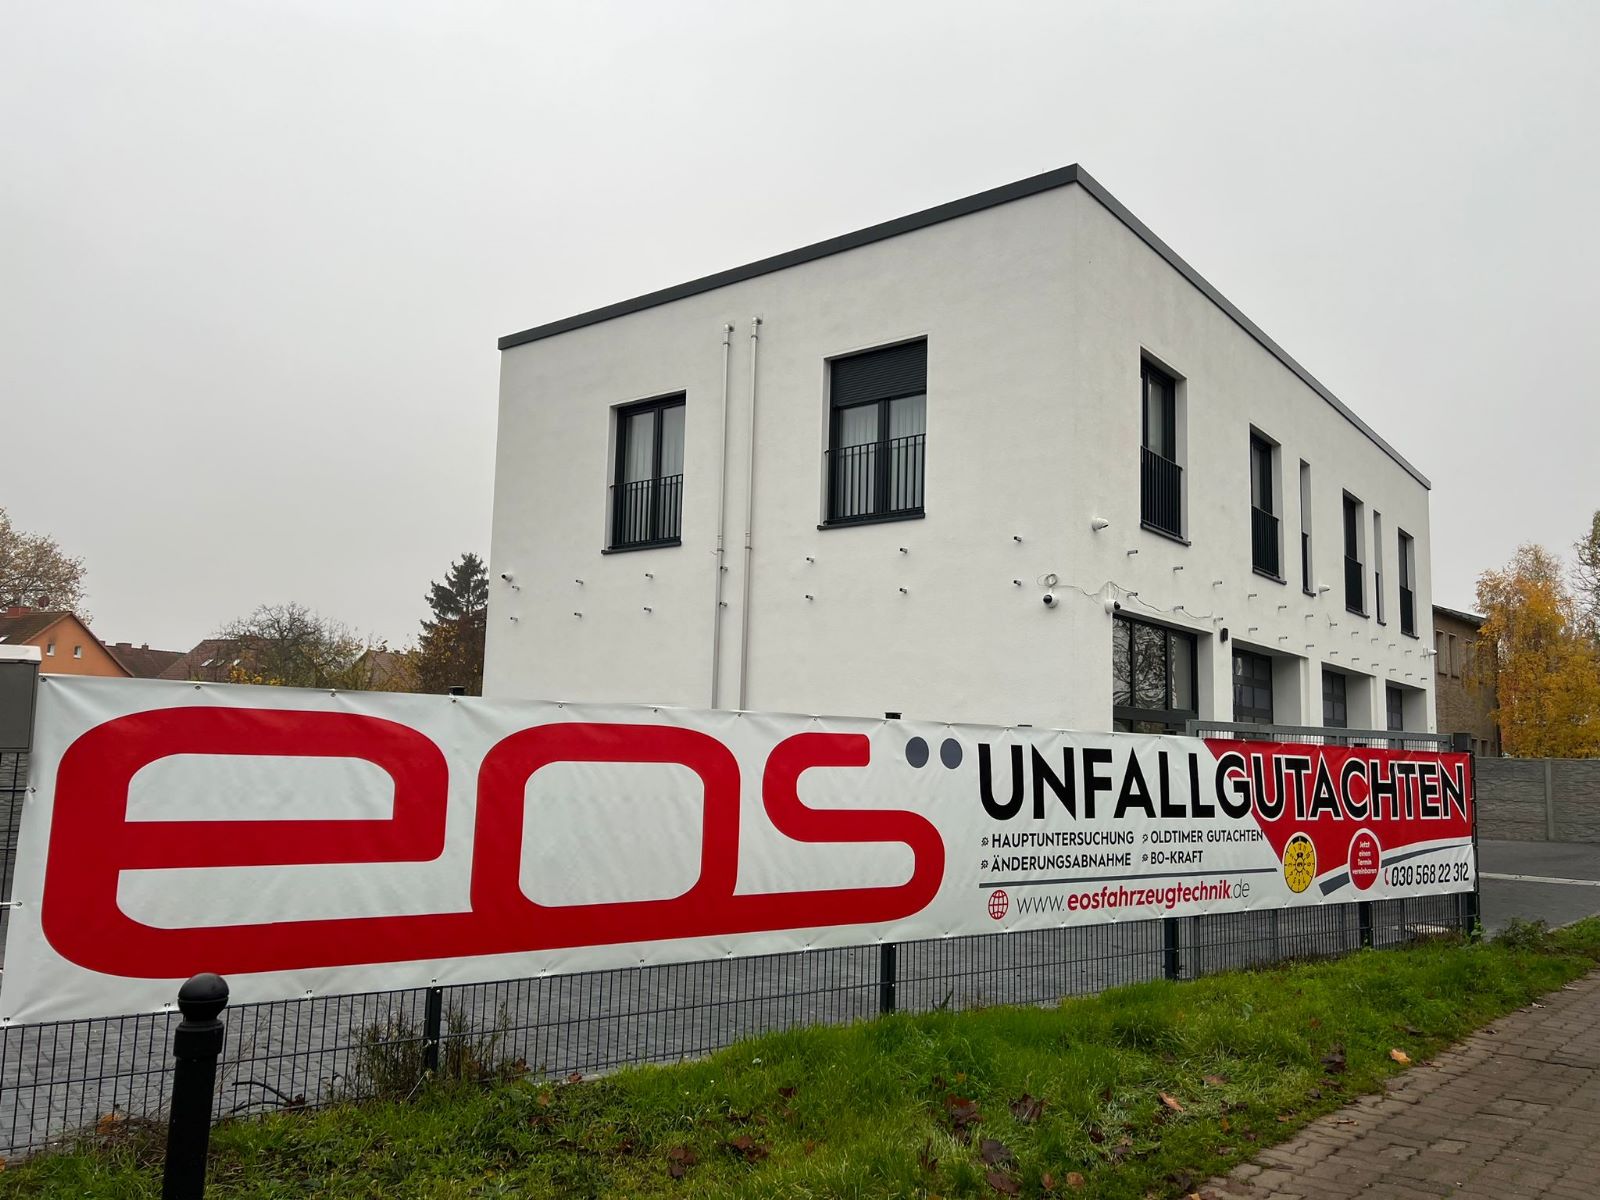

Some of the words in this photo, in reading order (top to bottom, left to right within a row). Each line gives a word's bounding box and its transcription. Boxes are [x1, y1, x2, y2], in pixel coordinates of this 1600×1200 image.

[978, 743, 1467, 822] UNFALLGUTACHTEN
[41, 706, 945, 978] eos
[992, 831, 1134, 848] HAUPTUNTERSUCHUNG
[1150, 830, 1203, 843] OLDTIMER
[1207, 829, 1264, 842] GUTACHTEN
[991, 853, 1131, 872] ÄNDERUNGSABNAHME
[1150, 850, 1203, 864] BO-KRAFT
[1391, 866, 1413, 887] 030
[1416, 864, 1436, 885] 568
[1438, 863, 1451, 883] 22
[1453, 862, 1469, 882] 312
